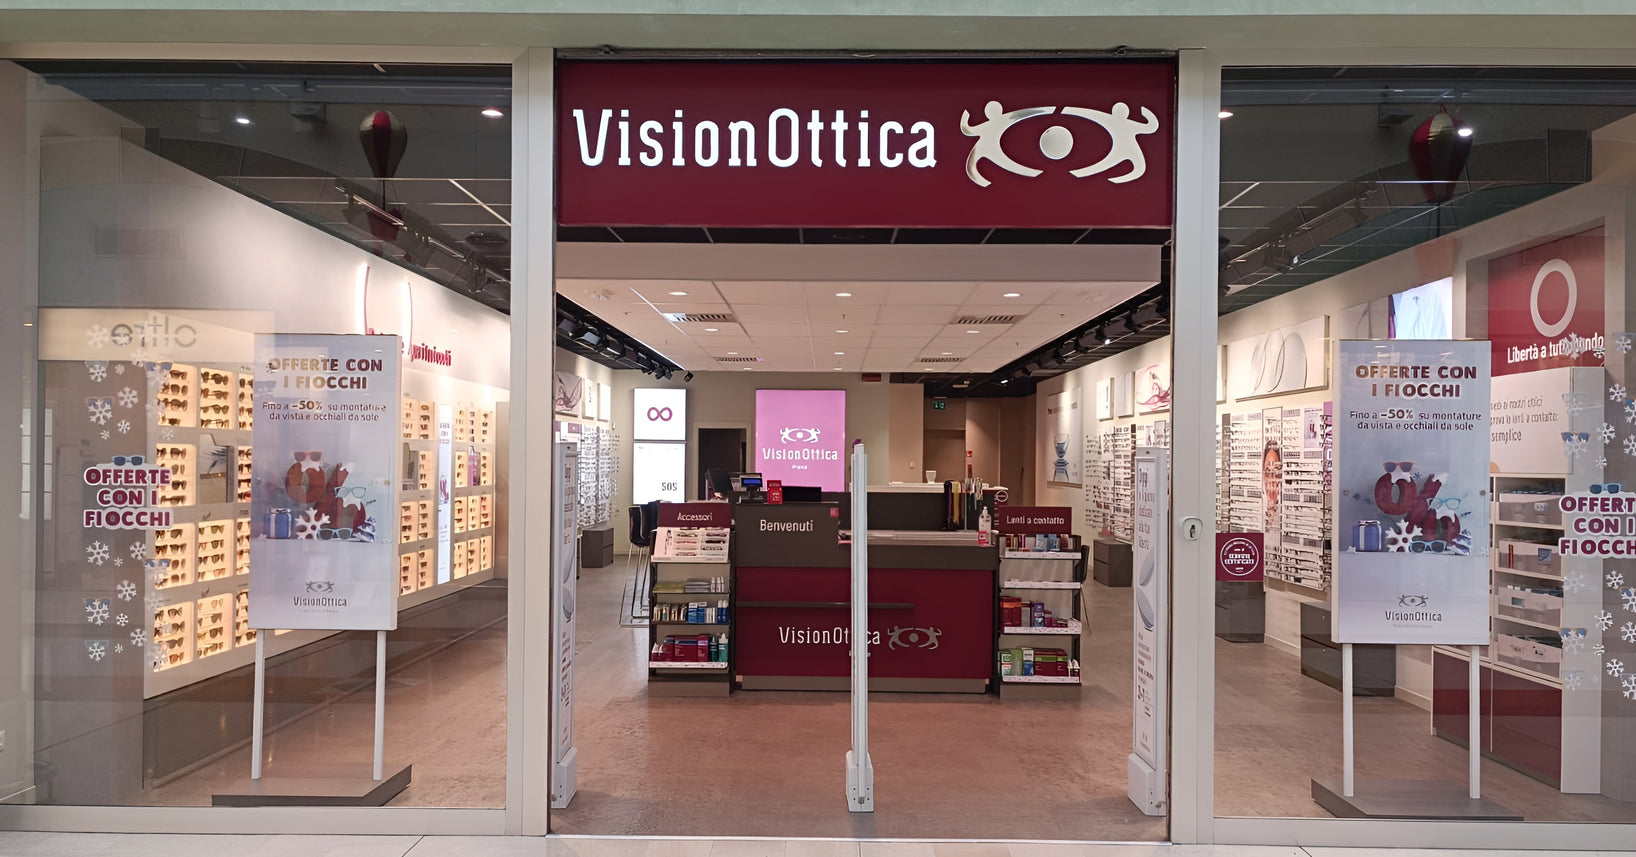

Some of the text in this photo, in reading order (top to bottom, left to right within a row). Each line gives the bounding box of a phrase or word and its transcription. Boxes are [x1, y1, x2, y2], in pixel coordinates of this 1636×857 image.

[573, 107, 937, 168] VisionOttica
[1507, 342, 1539, 364] Libertà
[1540, 345, 1547, 358] a
[267, 358, 383, 372] OFFERTE CON
[1355, 365, 1477, 379] OFFERTE CON
[283, 375, 368, 389] I FIOCCHI
[1371, 383, 1460, 397] I FIOCCHI
[269, 412, 280, 420] da
[282, 412, 304, 421] vista
[313, 412, 346, 421] occhiali
[347, 413, 359, 421] da
[1349, 410, 1370, 419] Fino
[1380, 408, 1414, 419] -50%
[1418, 412, 1430, 420] su
[1432, 412, 1482, 421] montature
[1357, 421, 1368, 430] da
[1370, 421, 1393, 430] vista
[1403, 421, 1439, 431] occhiali
[1440, 422, 1452, 431] da
[1454, 422, 1474, 431] sole
[762, 448, 838, 460] VisionOttica
[85, 468, 170, 484] OFFERTE
[98, 489, 157, 505] CON I
[1560, 496, 1636, 513] OFFERT
[85, 511, 170, 526] FIOCCHI
[677, 512, 713, 521] Accessori
[1006, 515, 1026, 525] Lenti
[1033, 516, 1065, 525] contatto
[760, 519, 813, 532] Benvenuti
[1574, 518, 1634, 533] CON I
[1560, 539, 1636, 554] FIOCCH
[293, 596, 347, 607] VisionOttica
[1385, 610, 1442, 622] VisionOttica
[778, 626, 881, 645] VisionOtca
